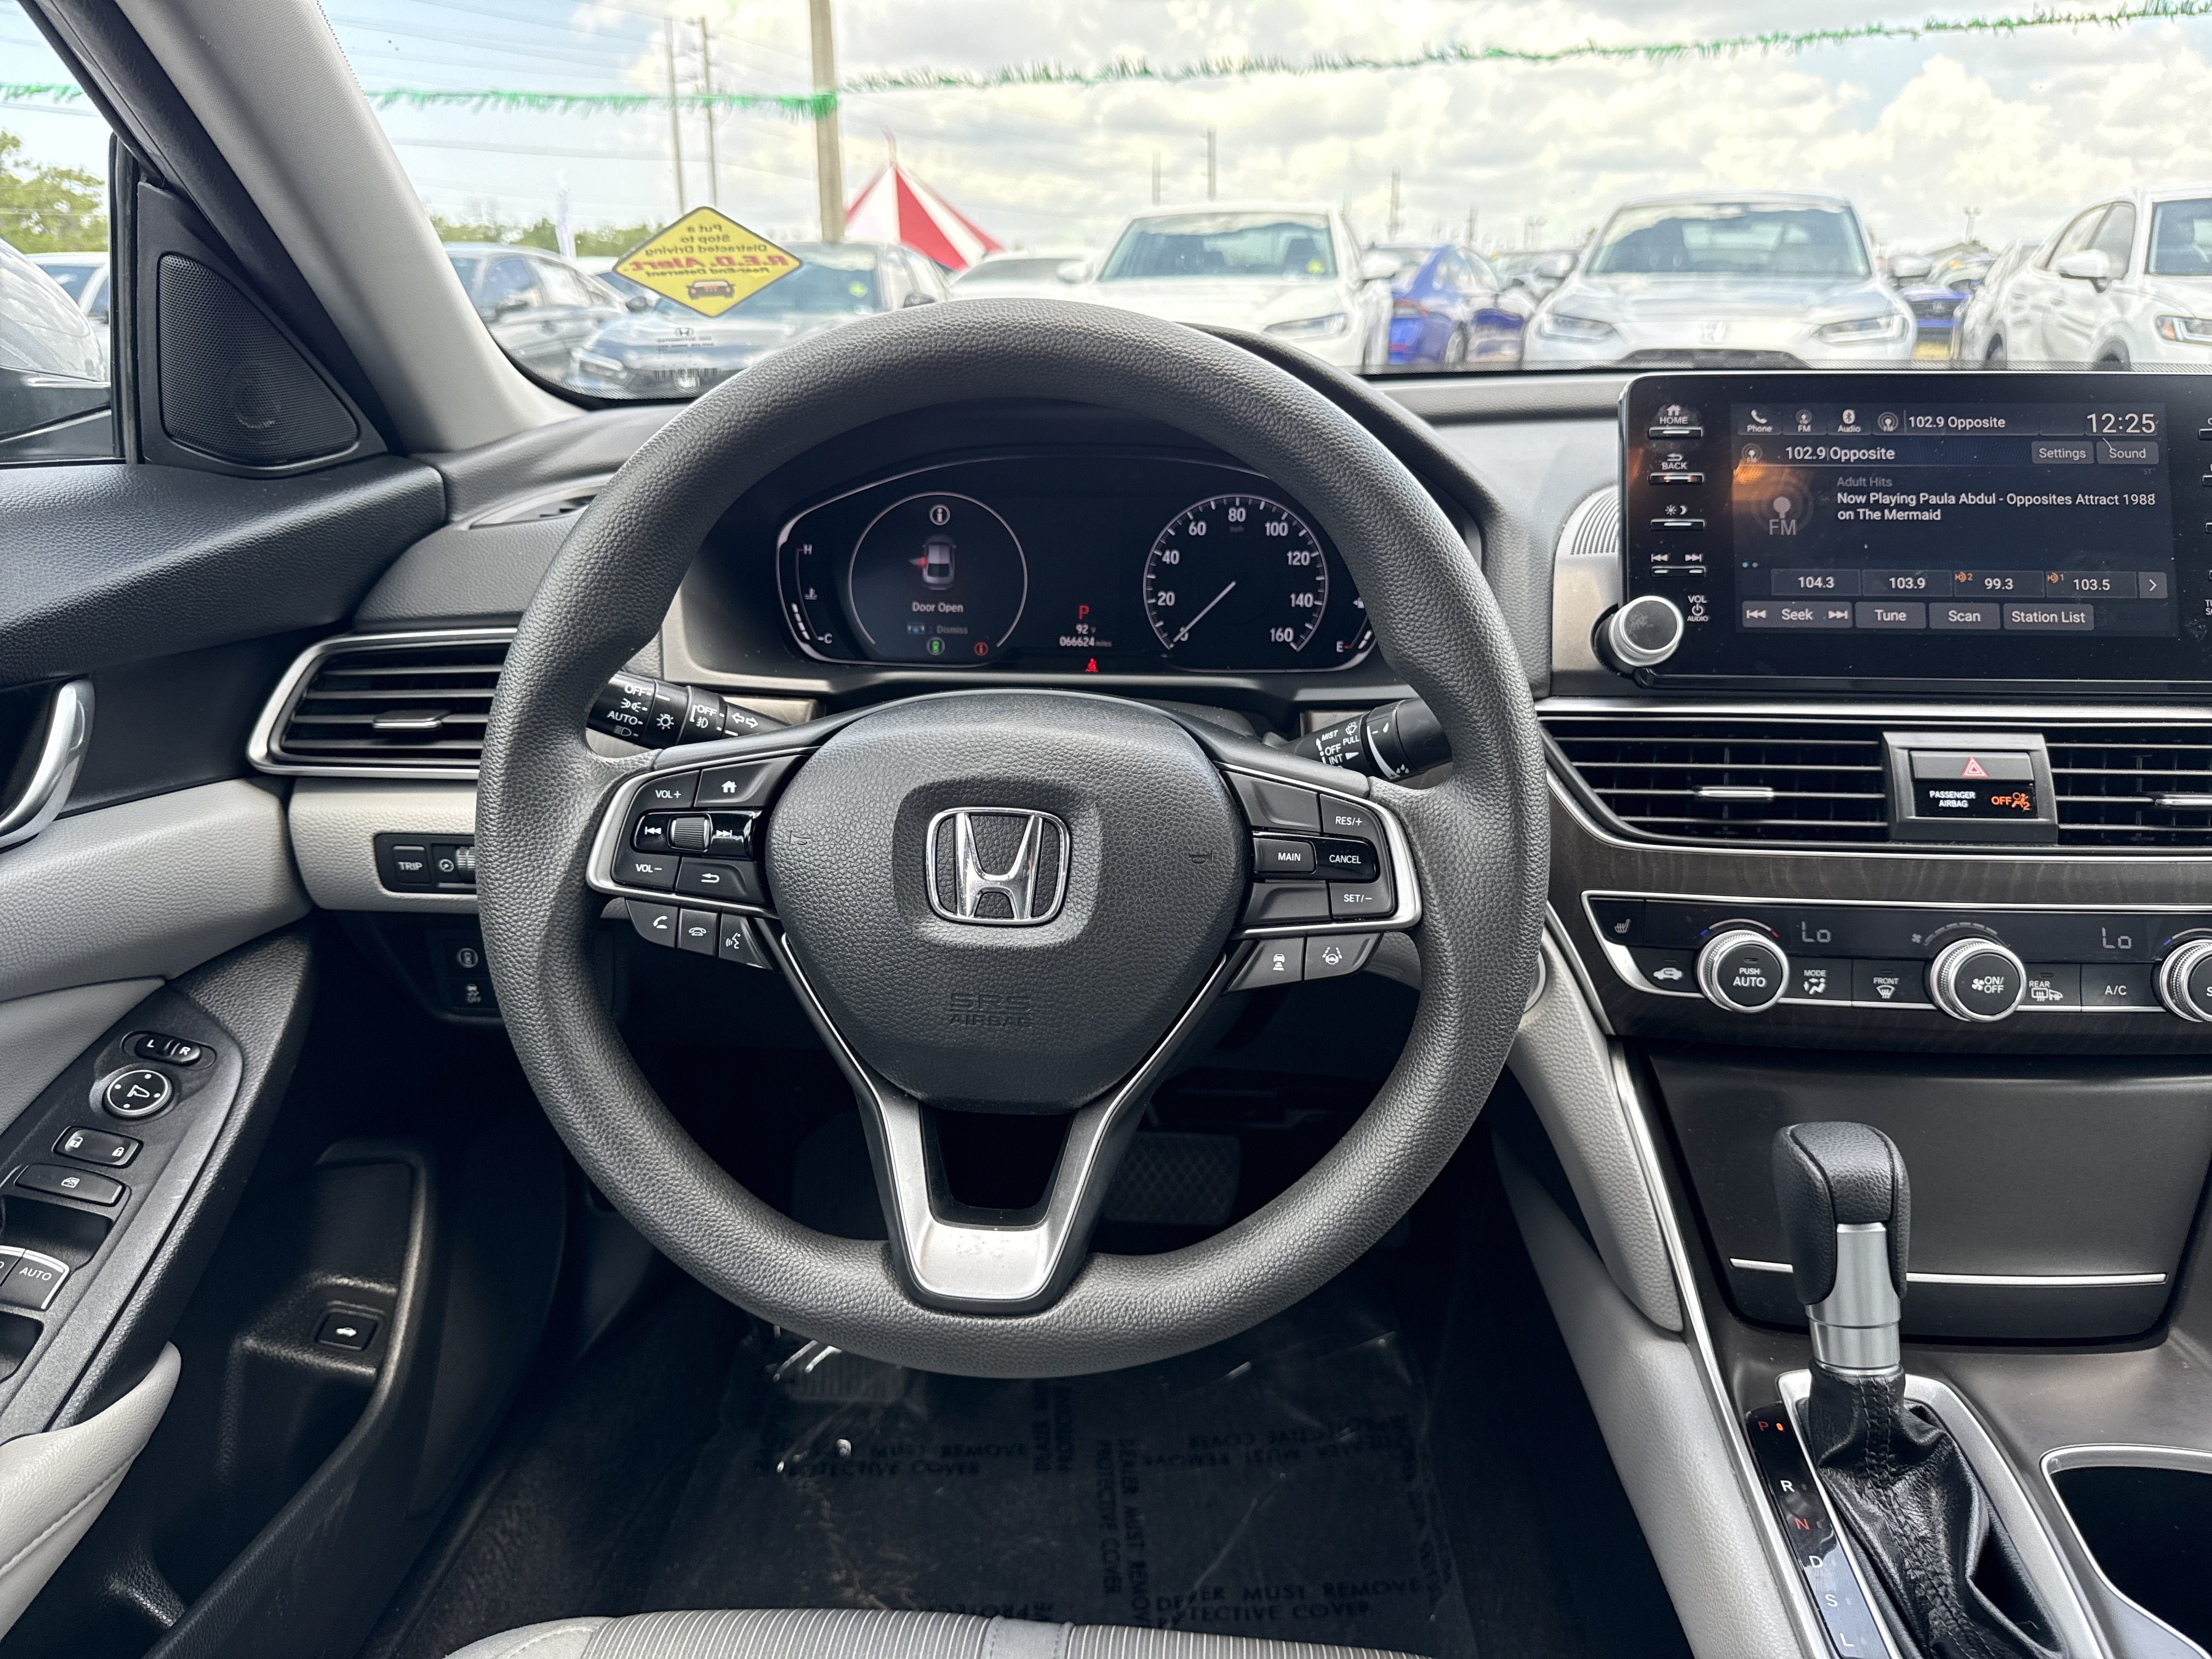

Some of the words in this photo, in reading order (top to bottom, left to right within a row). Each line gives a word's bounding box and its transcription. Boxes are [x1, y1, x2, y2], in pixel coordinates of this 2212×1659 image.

[1659, 416, 1689, 425] HOME
[1909, 416, 1944, 428] 102.9
[1948, 416, 2006, 430] Opposite
[2086, 413, 2155, 434] 12:25
[1747, 424, 1773, 432] Phone
[1838, 425, 1861, 433] Audio
[1785, 446, 1826, 460] 102.9
[1830, 446, 1895, 462] Opposite
[2039, 447, 2087, 461] Settings
[2108, 447, 2147, 460] Sound
[1661, 461, 1688, 470] BACK
[1837, 476, 1866, 488] Adult
[1870, 476, 1893, 488] Hits
[1837, 493, 1866, 505] Now
[1870, 493, 1916, 507] Playing
[1919, 493, 1956, 505] Paula
[1959, 493, 1996, 505] Abdul
[2006, 493, 2073, 507] Opposites
[2075, 494, 2120, 505] Attract
[2123, 494, 2155, 505] 1988
[1228, 507, 1246, 522] 80
[1838, 511, 1854, 520] on
[1857, 509, 1881, 520] The
[1884, 509, 1941, 521] Mermaid
[1188, 522, 1206, 536] 60
[1264, 522, 1289, 537] 100
[1768, 520, 1798, 536] FM
[803, 544, 812, 554] H
[1161, 550, 1180, 565] 40
[1286, 551, 1311, 566] 120
[1798, 576, 1835, 589] 104.3
[1889, 577, 1926, 590] 103.9
[1984, 578, 2014, 590] 99.3
[2073, 579, 2111, 591] 103.5
[1157, 591, 1175, 606] 20
[1290, 592, 1313, 608] 140
[1688, 595, 1707, 603] VOL
[912, 601, 935, 612] Door
[938, 601, 964, 613] Open
[1079, 605, 1090, 620] P
[1781, 608, 1813, 621] Seek
[1874, 609, 1907, 622] Tune
[1948, 610, 1982, 623] Scan
[2011, 610, 2058, 624] Station
[2061, 611, 2086, 624] List
[936, 625, 968, 634] Dismiss
[1076, 624, 1089, 634] 92
[1269, 627, 1294, 642] 160
[823, 634, 833, 644] C
[1059, 636, 1095, 647] 066624
[1336, 641, 1344, 652] E
[624, 684, 647, 696] OFF
[697, 704, 717, 716] OFF
[606, 710, 639, 725] AUTO
[1321, 729, 1339, 741] MIST
[1342, 735, 1360, 746] PULL
[1324, 743, 1342, 757] OFF
[1329, 754, 1343, 766] INT
[1929, 790, 1976, 799] PASSENGER
[1991, 795, 2012, 805] OFF
[1938, 799, 1968, 808] AIRBAG
[1278, 852, 1301, 862] MAIN
[1329, 854, 1362, 864] CANCEL
[397, 861, 423, 871] TRIP
[1801, 921, 1831, 943] Lo
[2102, 927, 2132, 950] Lo
[1739, 967, 1760, 975] PUSH
[1803, 969, 1827, 978] MODE
[1733, 976, 1766, 988] AUTO
[1873, 977, 1899, 985] FRONT
[1984, 975, 2005, 986] ON/
[1984, 984, 2004, 994] OFF
[2104, 985, 2127, 996] A/C
[949, 993, 1031, 1014] SRS
[147, 1039, 154, 1048] L
[179, 1046, 190, 1056] R
[19, 1266, 52, 1281] AUTO
[1758, 1420, 1769, 1431] P
[1780, 1480, 1795, 1492] R
[1795, 1518, 1810, 1530] N
[1809, 1555, 1824, 1568] D
[1243, 1584, 1307, 1602] MUST
[1323, 1576, 1420, 1599] REMOVE
[1825, 1594, 1838, 1607] S
[1291, 1600, 1370, 1619] COVER
[1839, 1633, 1855, 1647] L
